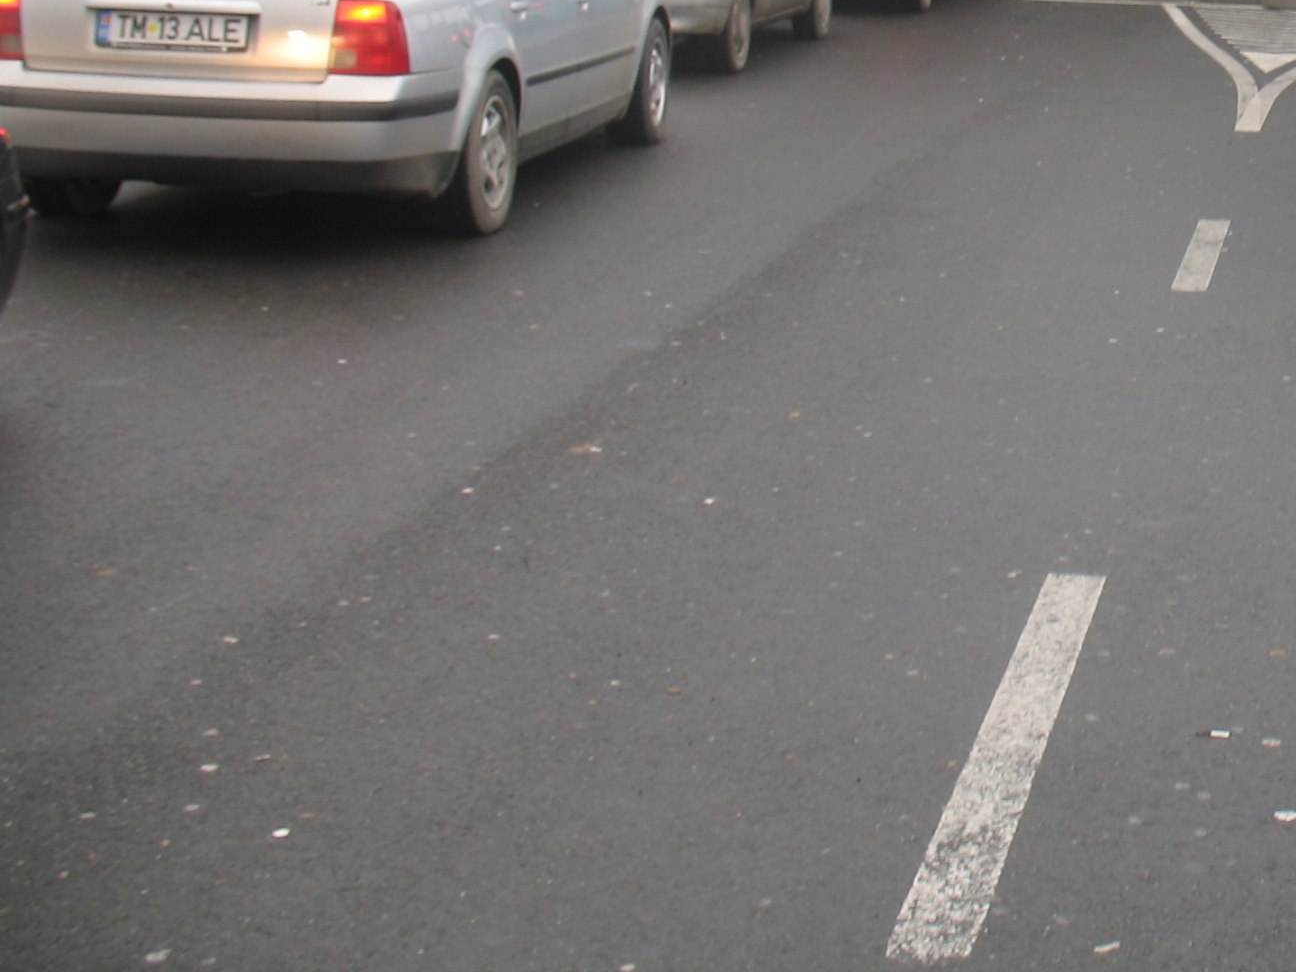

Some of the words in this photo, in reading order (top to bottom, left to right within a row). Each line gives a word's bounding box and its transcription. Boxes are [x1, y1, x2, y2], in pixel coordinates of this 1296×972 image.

[117, 14, 147, 39] TM
[158, 15, 180, 40] 13
[185, 16, 241, 43] ALE
